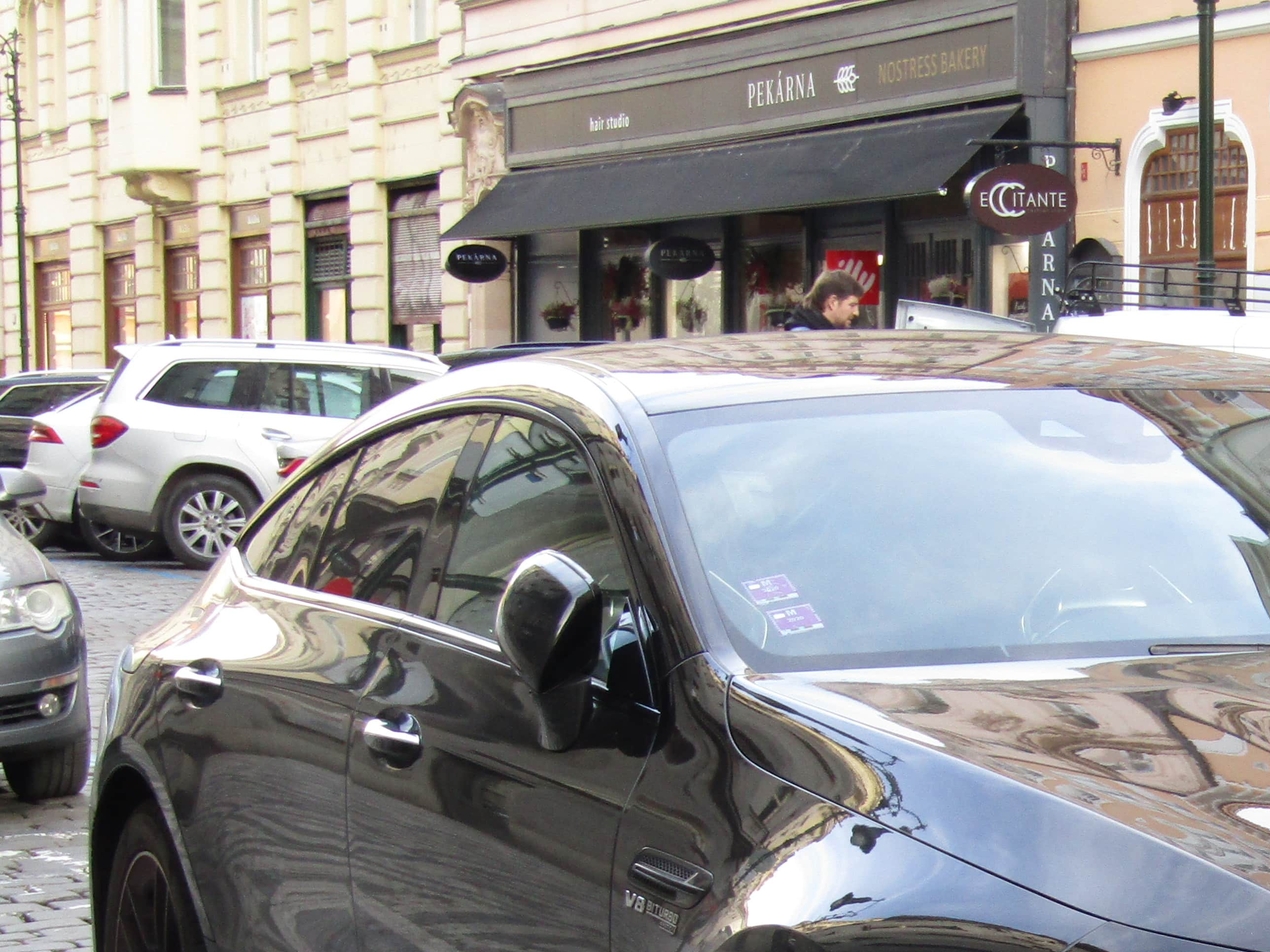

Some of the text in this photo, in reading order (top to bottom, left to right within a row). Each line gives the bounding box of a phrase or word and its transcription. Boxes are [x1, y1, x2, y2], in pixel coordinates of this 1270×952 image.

[878, 44, 988, 85] NOSTRESS BAKERY
[748, 71, 816, 108] PEKÁRNA
[589, 112, 630, 132] hair studio
[980, 182, 1067, 218] ECCITANTE
[625, 889, 646, 913] V8
